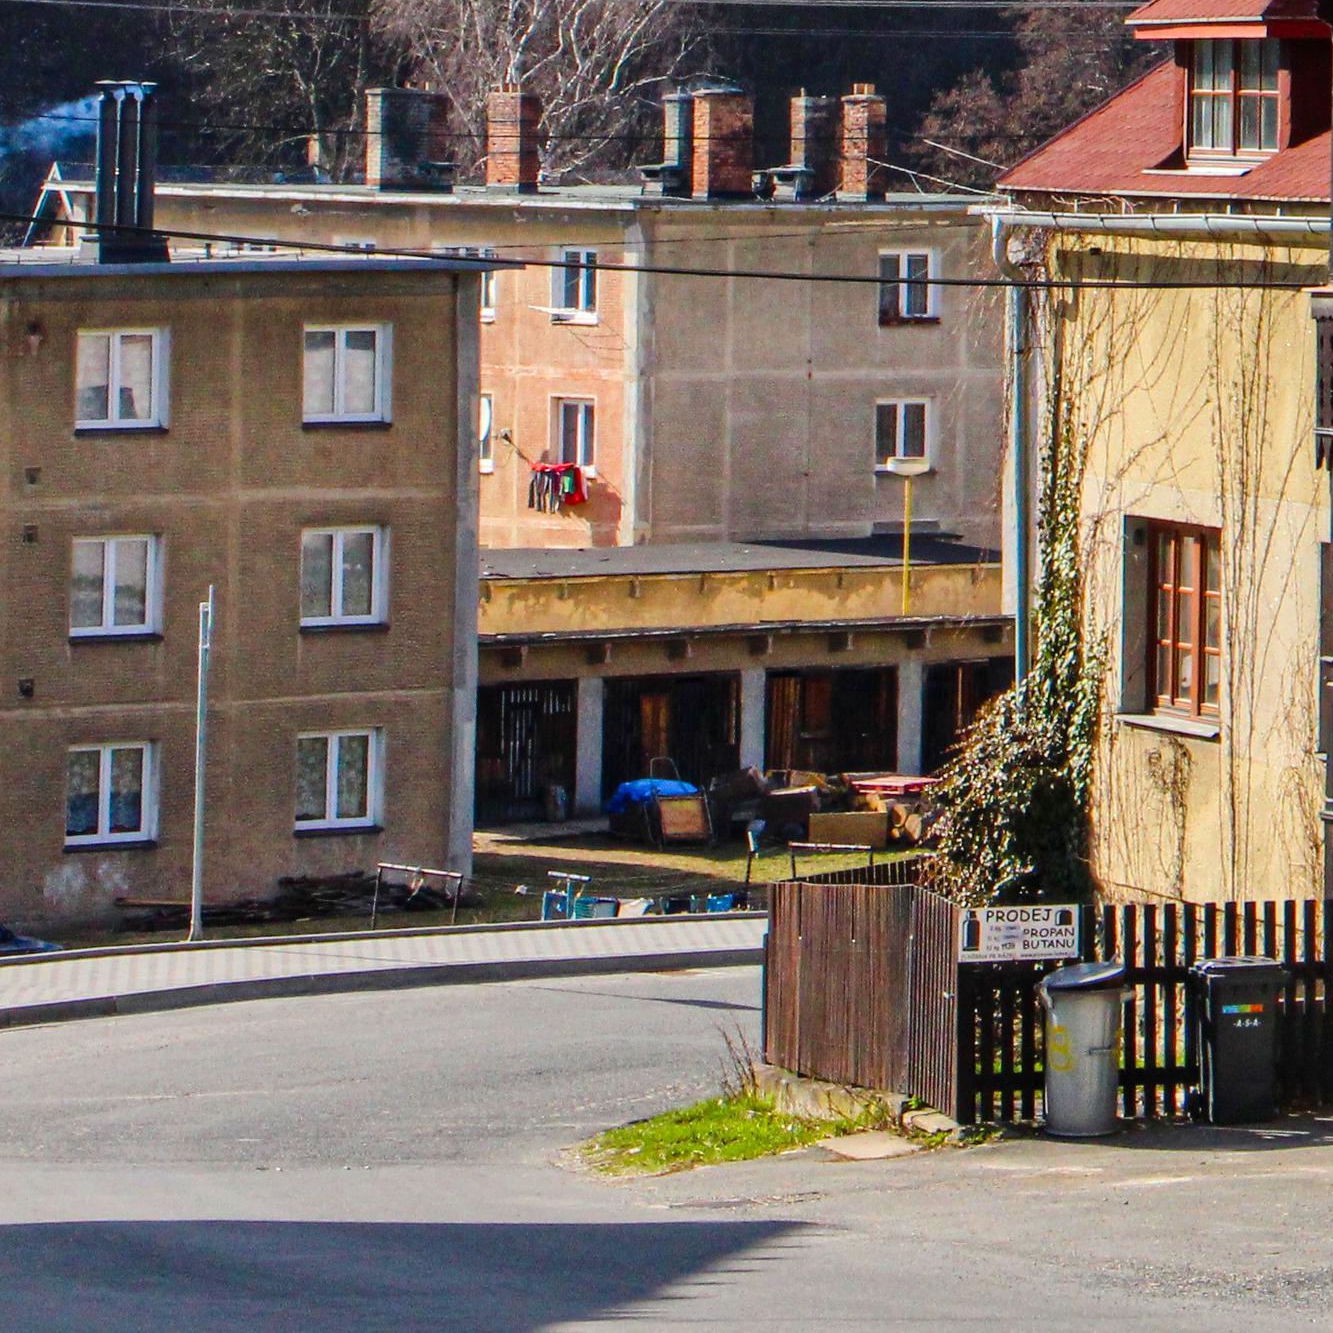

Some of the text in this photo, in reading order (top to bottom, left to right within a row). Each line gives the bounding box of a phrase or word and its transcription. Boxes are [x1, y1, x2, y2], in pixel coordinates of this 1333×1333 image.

[986, 908, 1052, 923] PRODEJ
[1023, 927, 1075, 938] PROPAN
[1022, 939, 1075, 950] BUTANU
